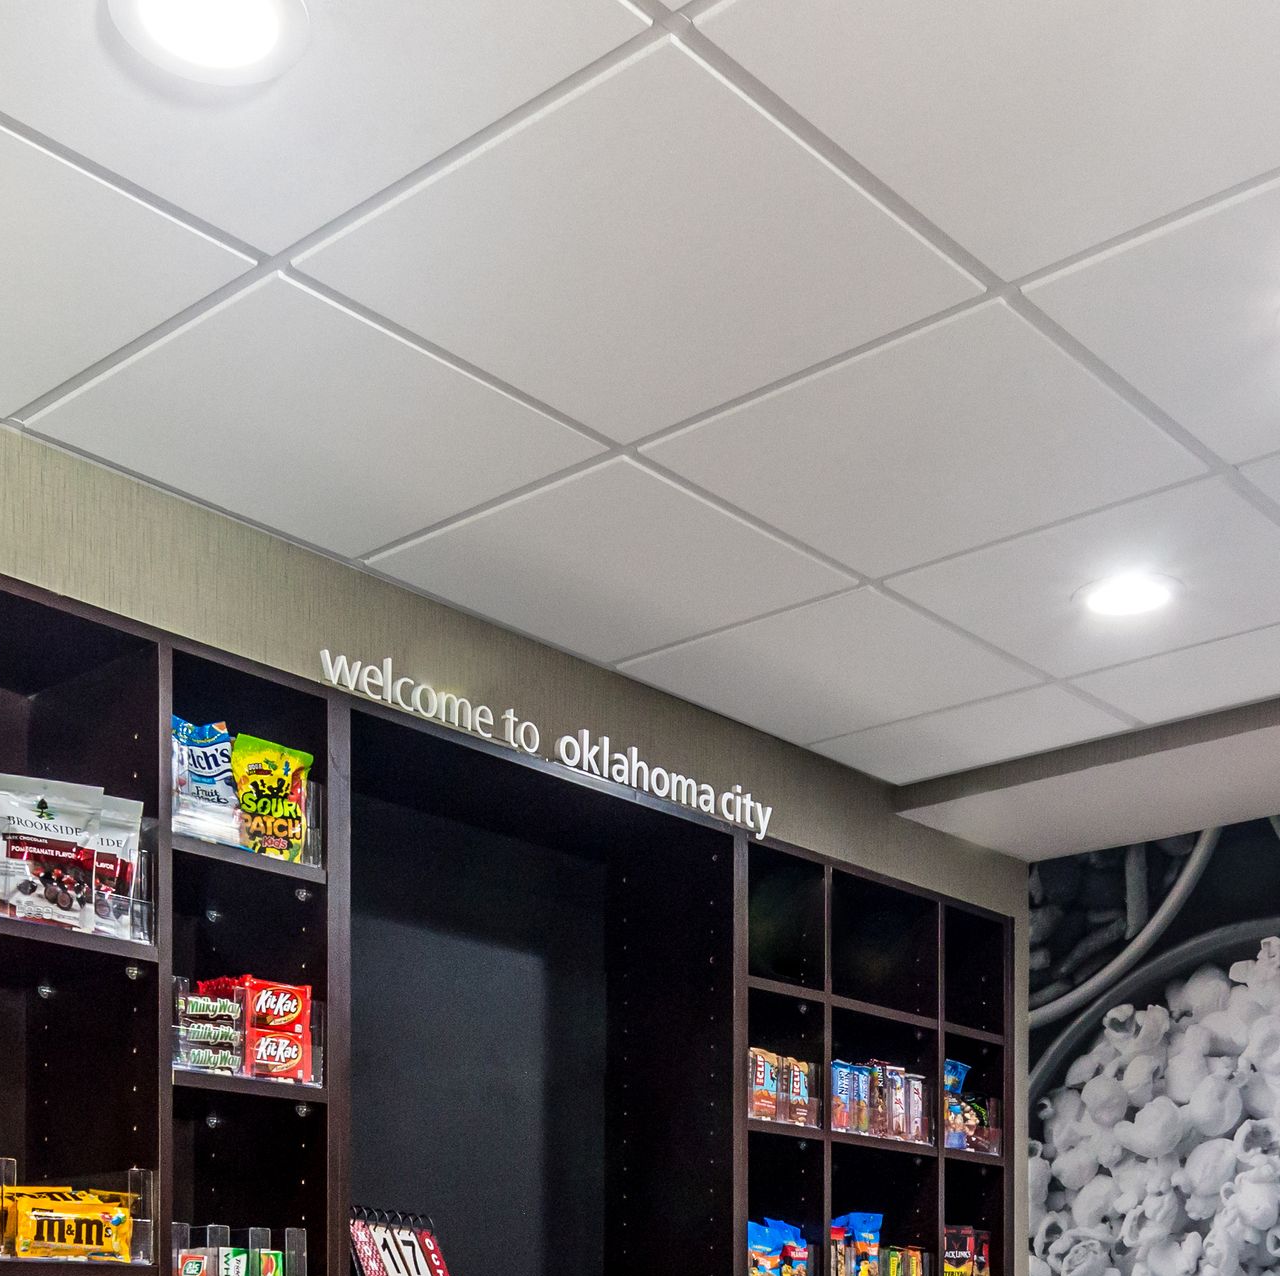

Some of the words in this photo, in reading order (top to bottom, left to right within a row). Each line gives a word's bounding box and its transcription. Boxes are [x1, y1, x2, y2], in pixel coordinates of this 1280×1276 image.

[320, 648, 494, 739] welcome
[501, 708, 540, 753] to
[556, 728, 716, 814] oklahoma
[721, 784, 773, 840] city
[241, 792, 299, 817] SOUR
[7, 815, 82, 837] BROOKSIDE
[241, 813, 302, 839] PATCH
[11, 846, 55, 857] POMEGRANATE
[262, 836, 289, 850] Kids
[95, 861, 115, 871] LAVOR
